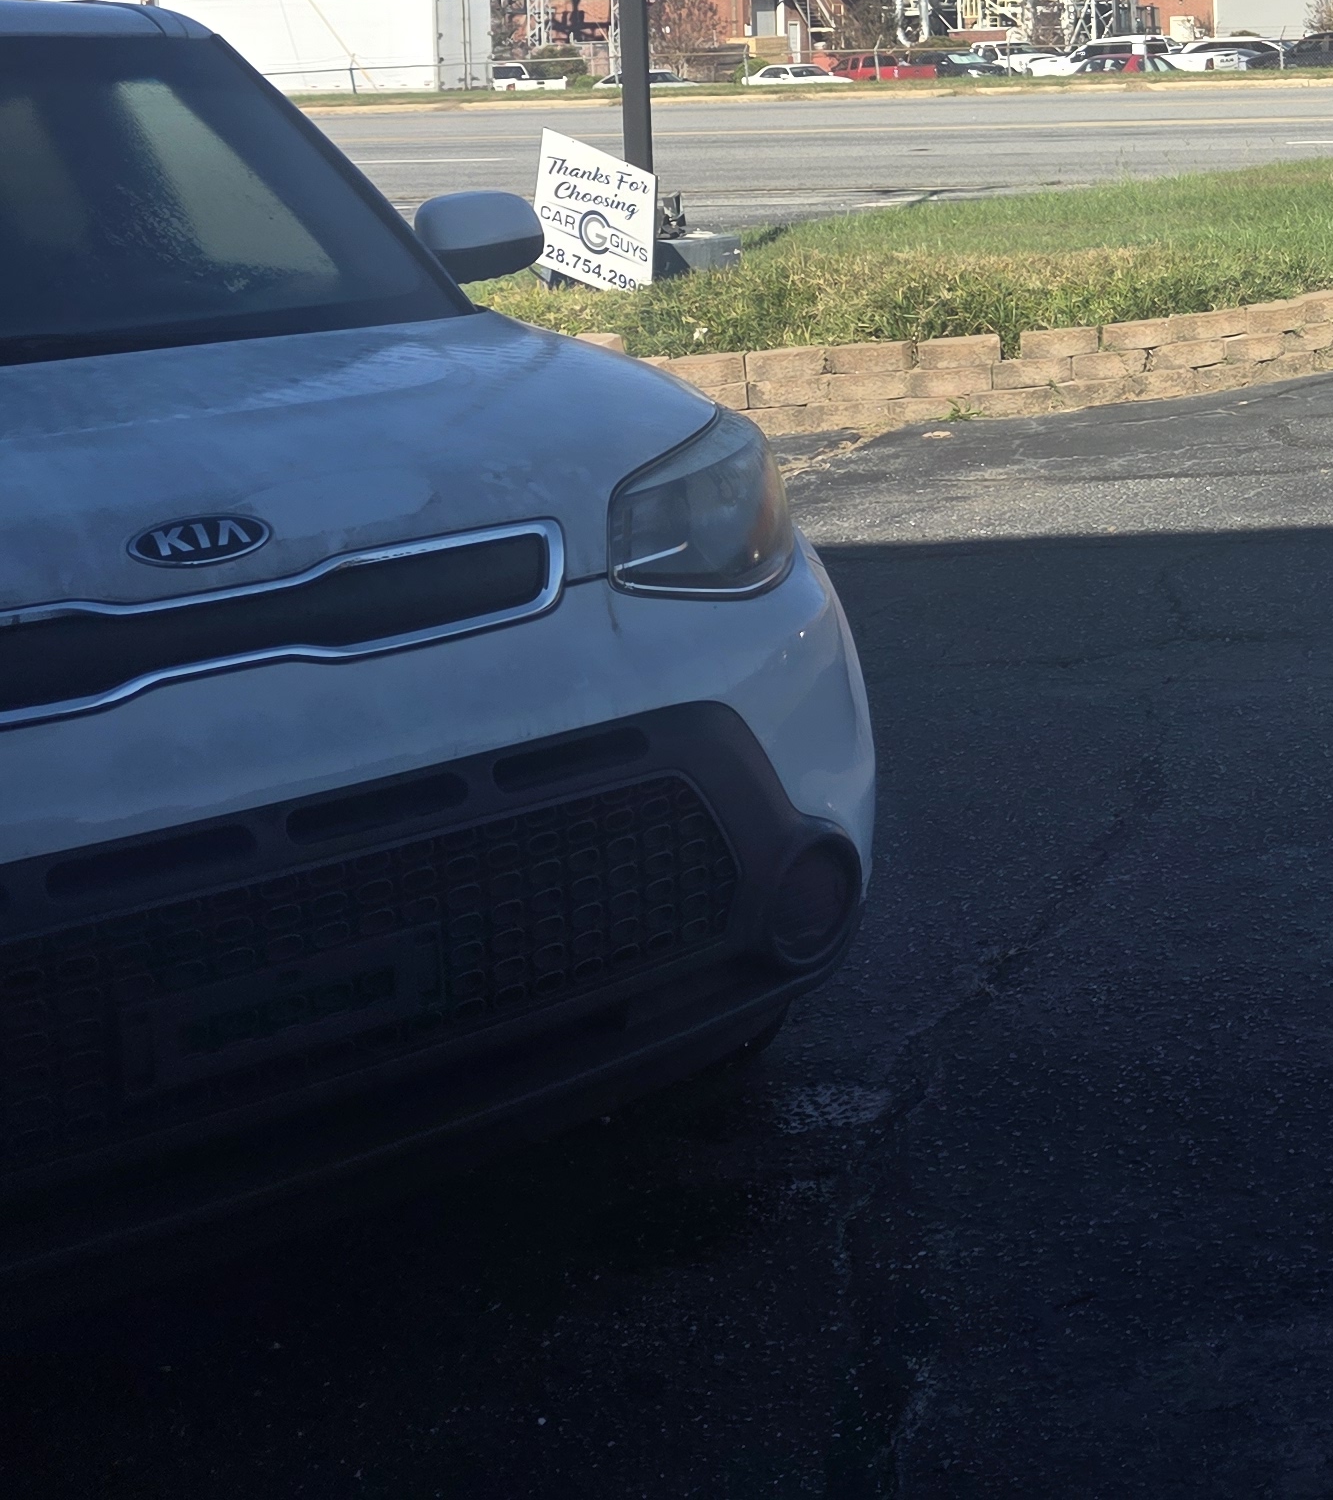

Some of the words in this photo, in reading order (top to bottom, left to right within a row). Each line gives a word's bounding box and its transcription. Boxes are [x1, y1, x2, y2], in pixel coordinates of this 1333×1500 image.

[547, 156, 611, 184] Thanks
[616, 171, 650, 194] For
[554, 181, 639, 220] Choosing
[540, 205, 576, 231] CAR
[609, 233, 648, 263] GUYS
[150, 519, 252, 557] KIA
